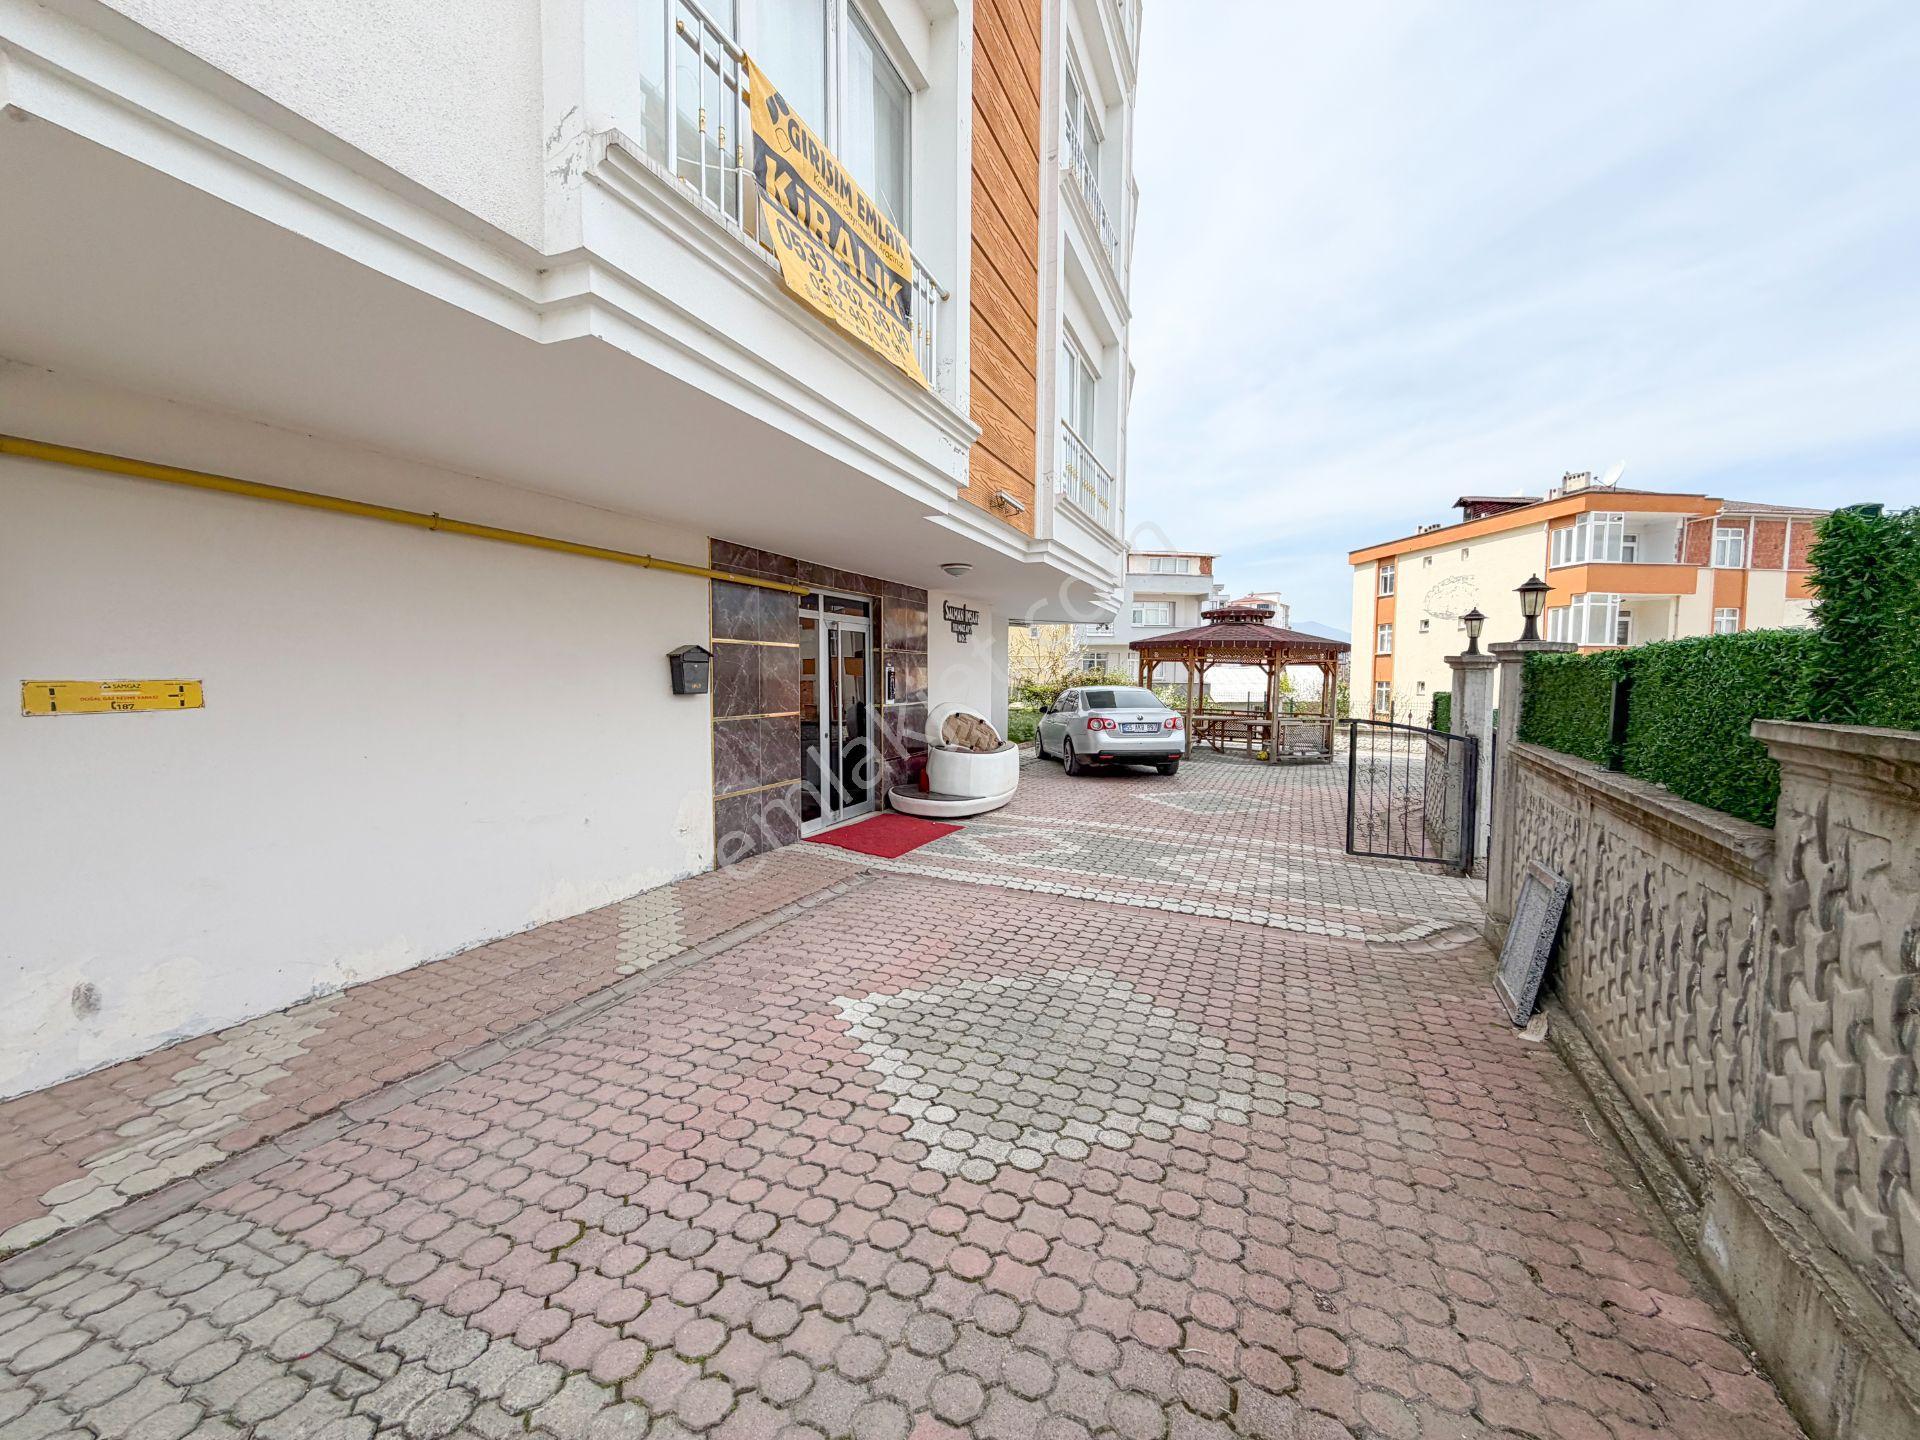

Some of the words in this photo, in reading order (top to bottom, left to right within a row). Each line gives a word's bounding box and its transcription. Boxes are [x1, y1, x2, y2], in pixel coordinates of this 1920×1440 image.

[857, 191, 905, 260] EMLAK
[776, 218, 831, 285] 0532
[868, 301, 890, 334] 36
